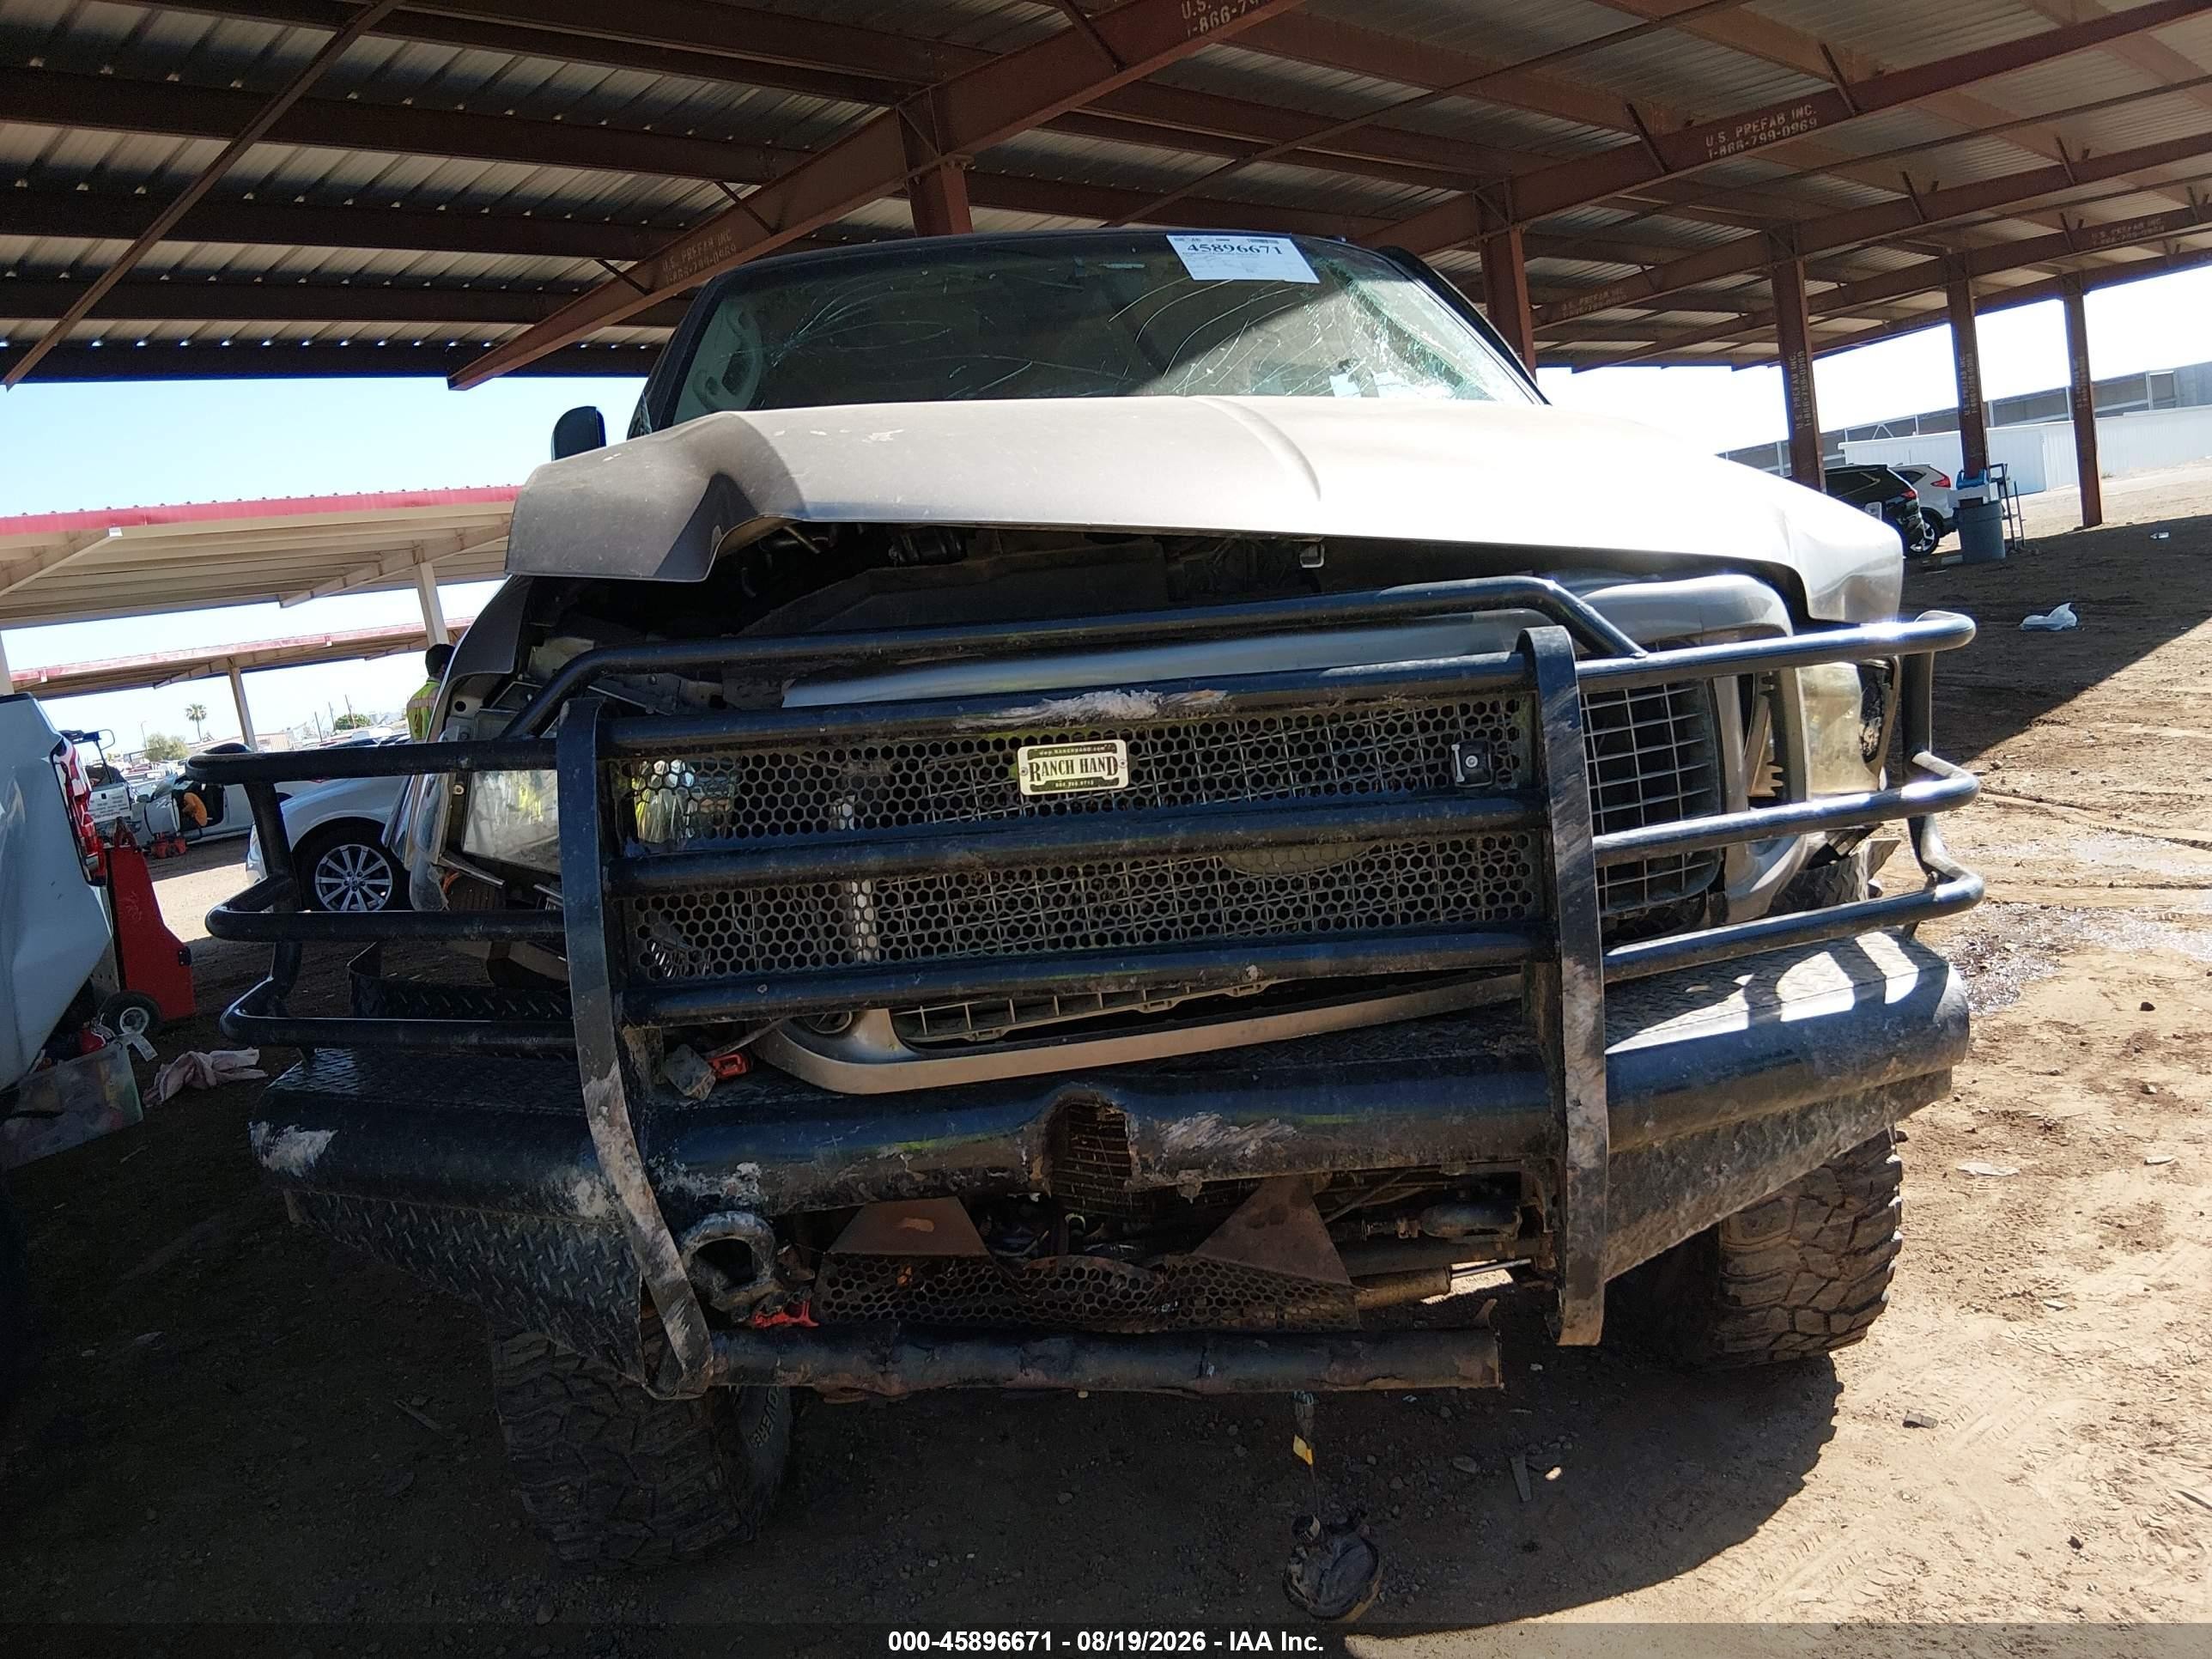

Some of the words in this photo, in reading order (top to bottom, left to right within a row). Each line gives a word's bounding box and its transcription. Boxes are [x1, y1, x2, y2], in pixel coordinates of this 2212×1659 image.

[1705, 131, 1729, 147] U.S.
[1735, 112, 1786, 137] PREFAB
[1791, 104, 1818, 119] INC.
[1188, 244, 1284, 255] 45896671
[1029, 759, 1075, 781] RANCH
[1079, 756, 1118, 775] HAND
